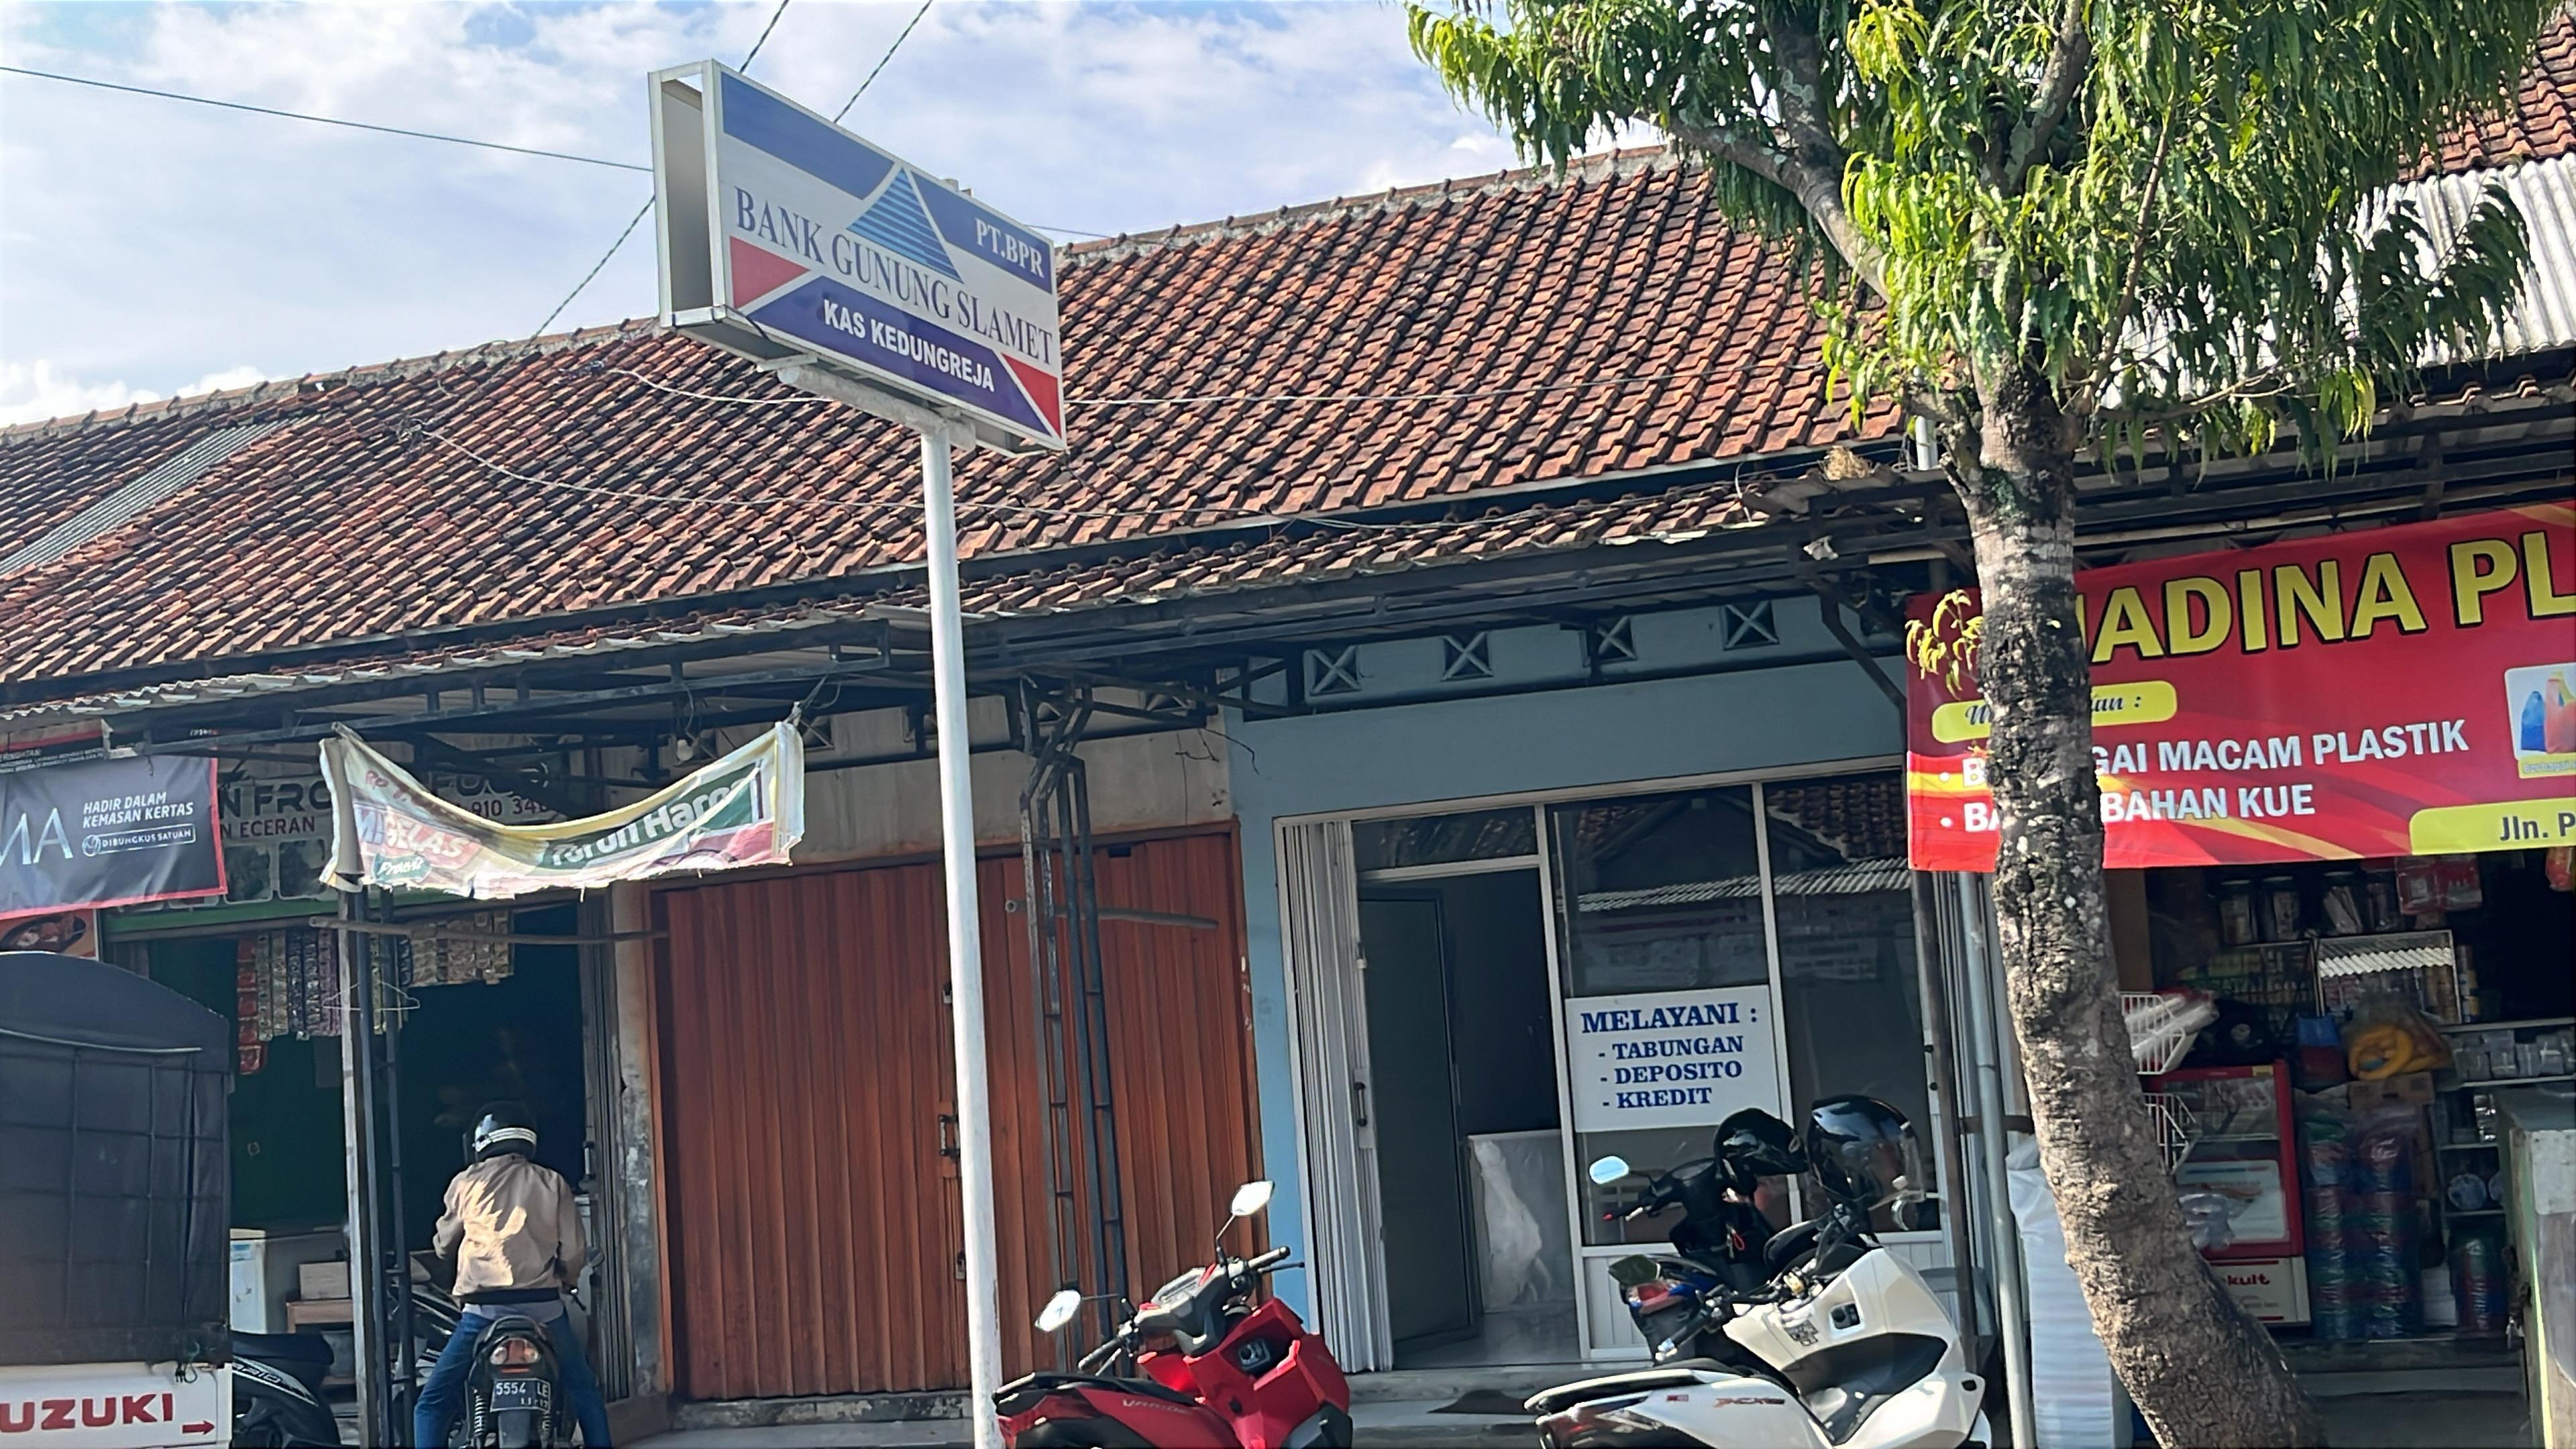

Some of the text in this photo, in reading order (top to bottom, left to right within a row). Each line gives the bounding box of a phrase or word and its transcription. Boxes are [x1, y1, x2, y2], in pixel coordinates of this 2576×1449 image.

[974, 217, 1045, 278] PT.BPR
[733, 186, 1053, 366] BANK GUNUNG SLAMET
[823, 299, 995, 392] KAS KEDUNGREJA
[2075, 551, 2428, 664] ADINA
[2157, 735, 2302, 773] MACAM
[2312, 718, 2470, 764] PLASTIK
[83, 792, 167, 815] HADIR DALAM
[2239, 782, 2316, 818] KUE
[83, 802, 194, 828] KEMASAN KERTAS
[240, 816, 315, 838] ECERAN
[102, 829, 191, 848] DIBUNGKUS SATUAN
[2500, 816, 2548, 841] Jln.
[1580, 1002, 1740, 1034] MELAYANI
[1612, 1036, 1743, 1060] TABUNGAN
[1614, 1060, 1742, 1085] DEPOSITO
[1617, 1087, 1712, 1109] KREDIT
[2224, 1274, 2269, 1286] kult
[496, 1382, 526, 1395] 5554
[0, 1393, 173, 1433] UZUKI
